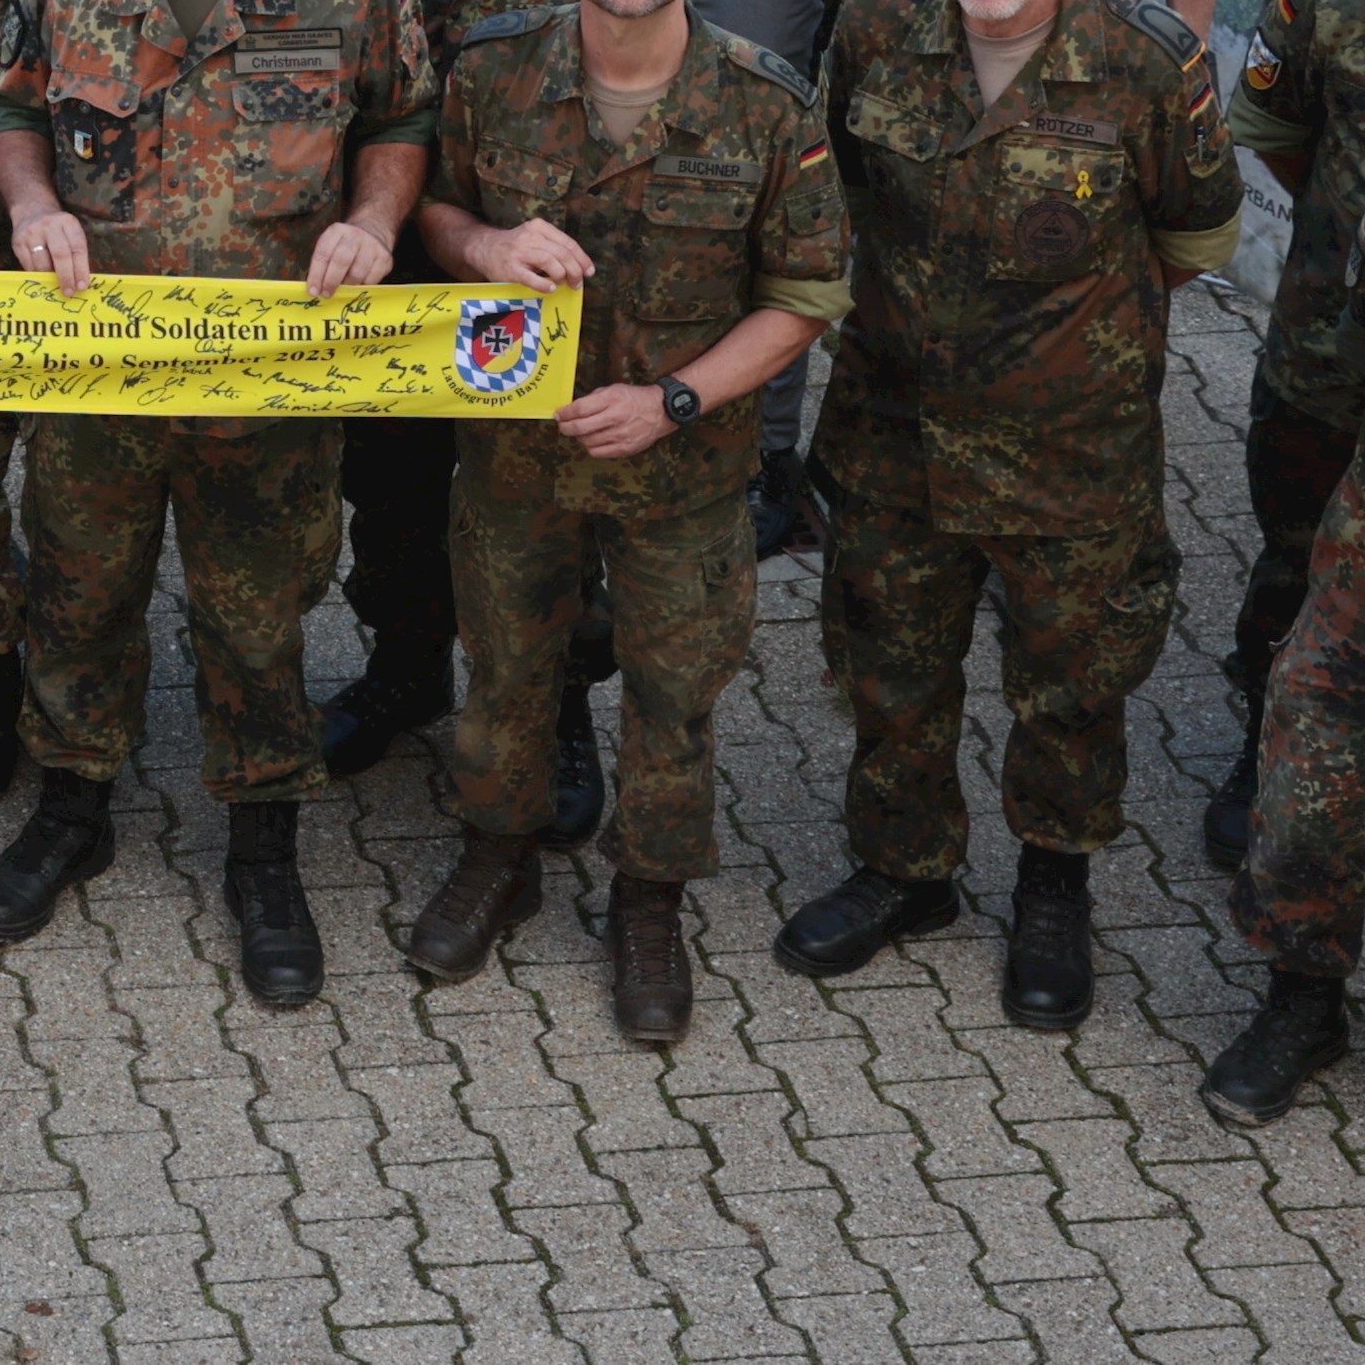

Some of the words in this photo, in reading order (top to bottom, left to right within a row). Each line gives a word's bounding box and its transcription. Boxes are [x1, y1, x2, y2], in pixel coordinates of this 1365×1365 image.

[251, 54, 323, 70] Christmann
[678, 159, 741, 178] BUCHNER
[90, 316, 142, 339] und
[150, 316, 269, 341] Soldaten
[278, 318, 313, 341] im
[322, 318, 425, 342] Einsatz
[9, 352, 33, 370] 2.
[44, 353, 80, 372] bis
[89, 353, 111, 370] 9.
[120, 349, 267, 371] September
[274, 348, 336, 362] 2023
[441, 365, 514, 407] Landesgruppe
[515, 363, 549, 398] Bayern
